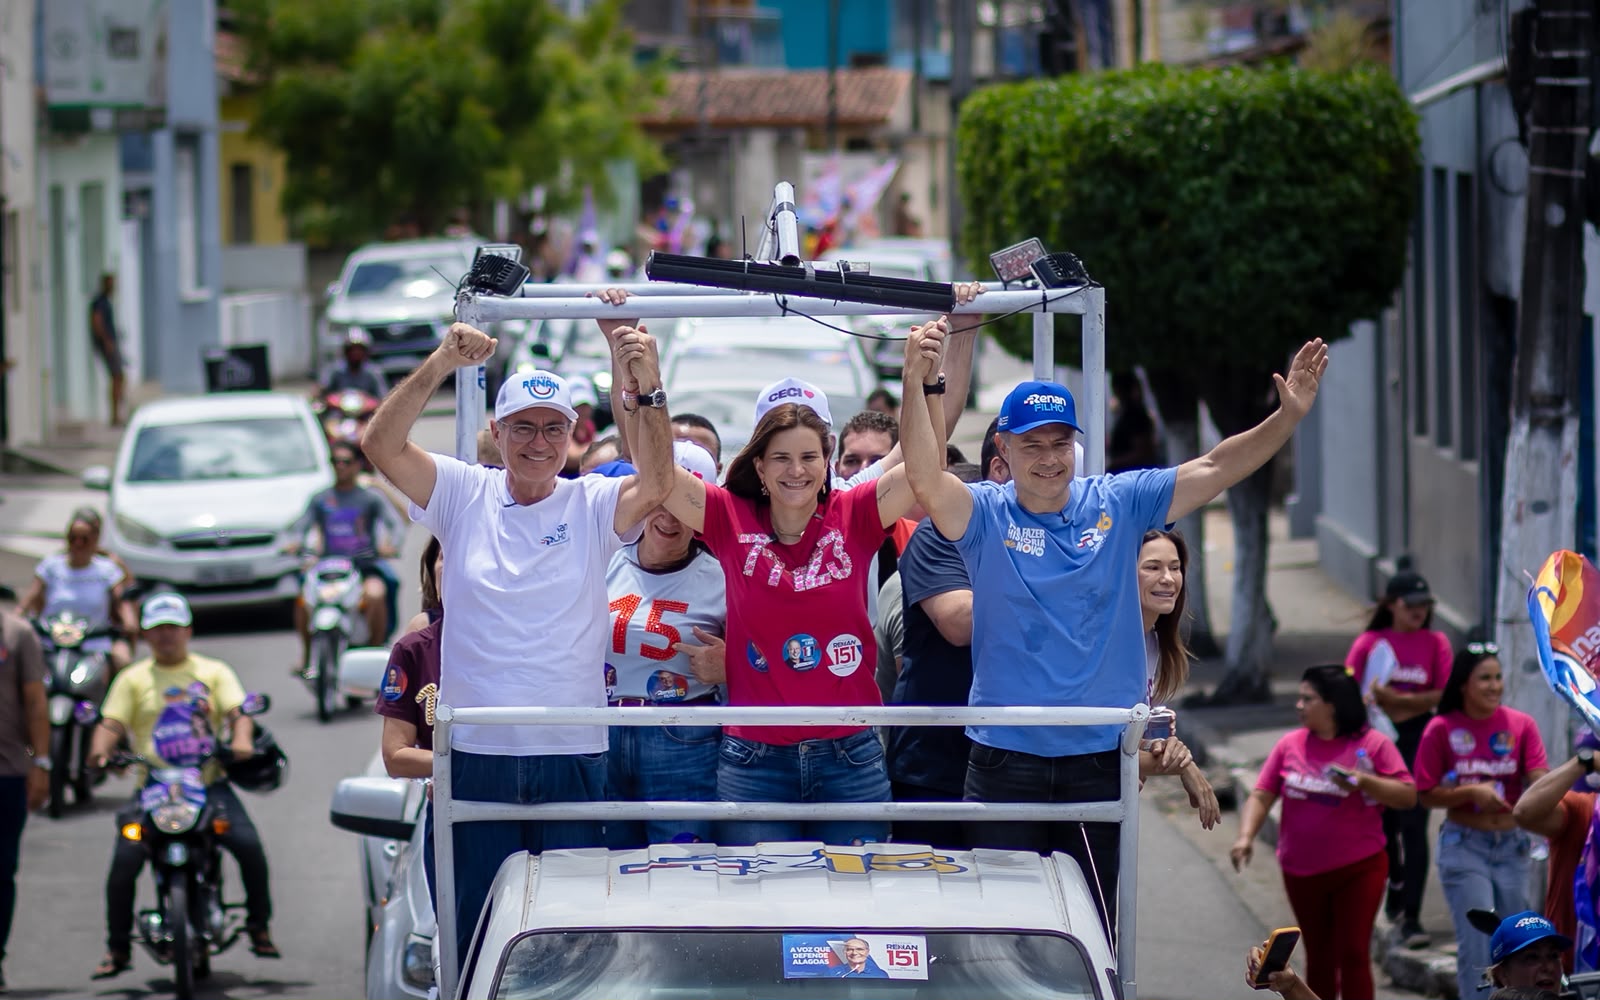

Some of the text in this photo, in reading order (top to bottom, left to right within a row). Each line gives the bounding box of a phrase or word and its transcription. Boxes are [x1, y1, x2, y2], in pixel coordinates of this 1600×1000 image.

[522, 379, 560, 391] RENAN
[768, 387, 802, 402] CECI
[1023, 393, 1067, 406] Renan
[1034, 404, 1065, 413] FILHO
[1022, 527, 1046, 539] FAZER
[1015, 541, 1044, 557] NOVO
[608, 593, 689, 662] 15
[832, 640, 857, 648] RENAN
[833, 645, 856, 665] 151
[887, 950, 919, 966] 151
